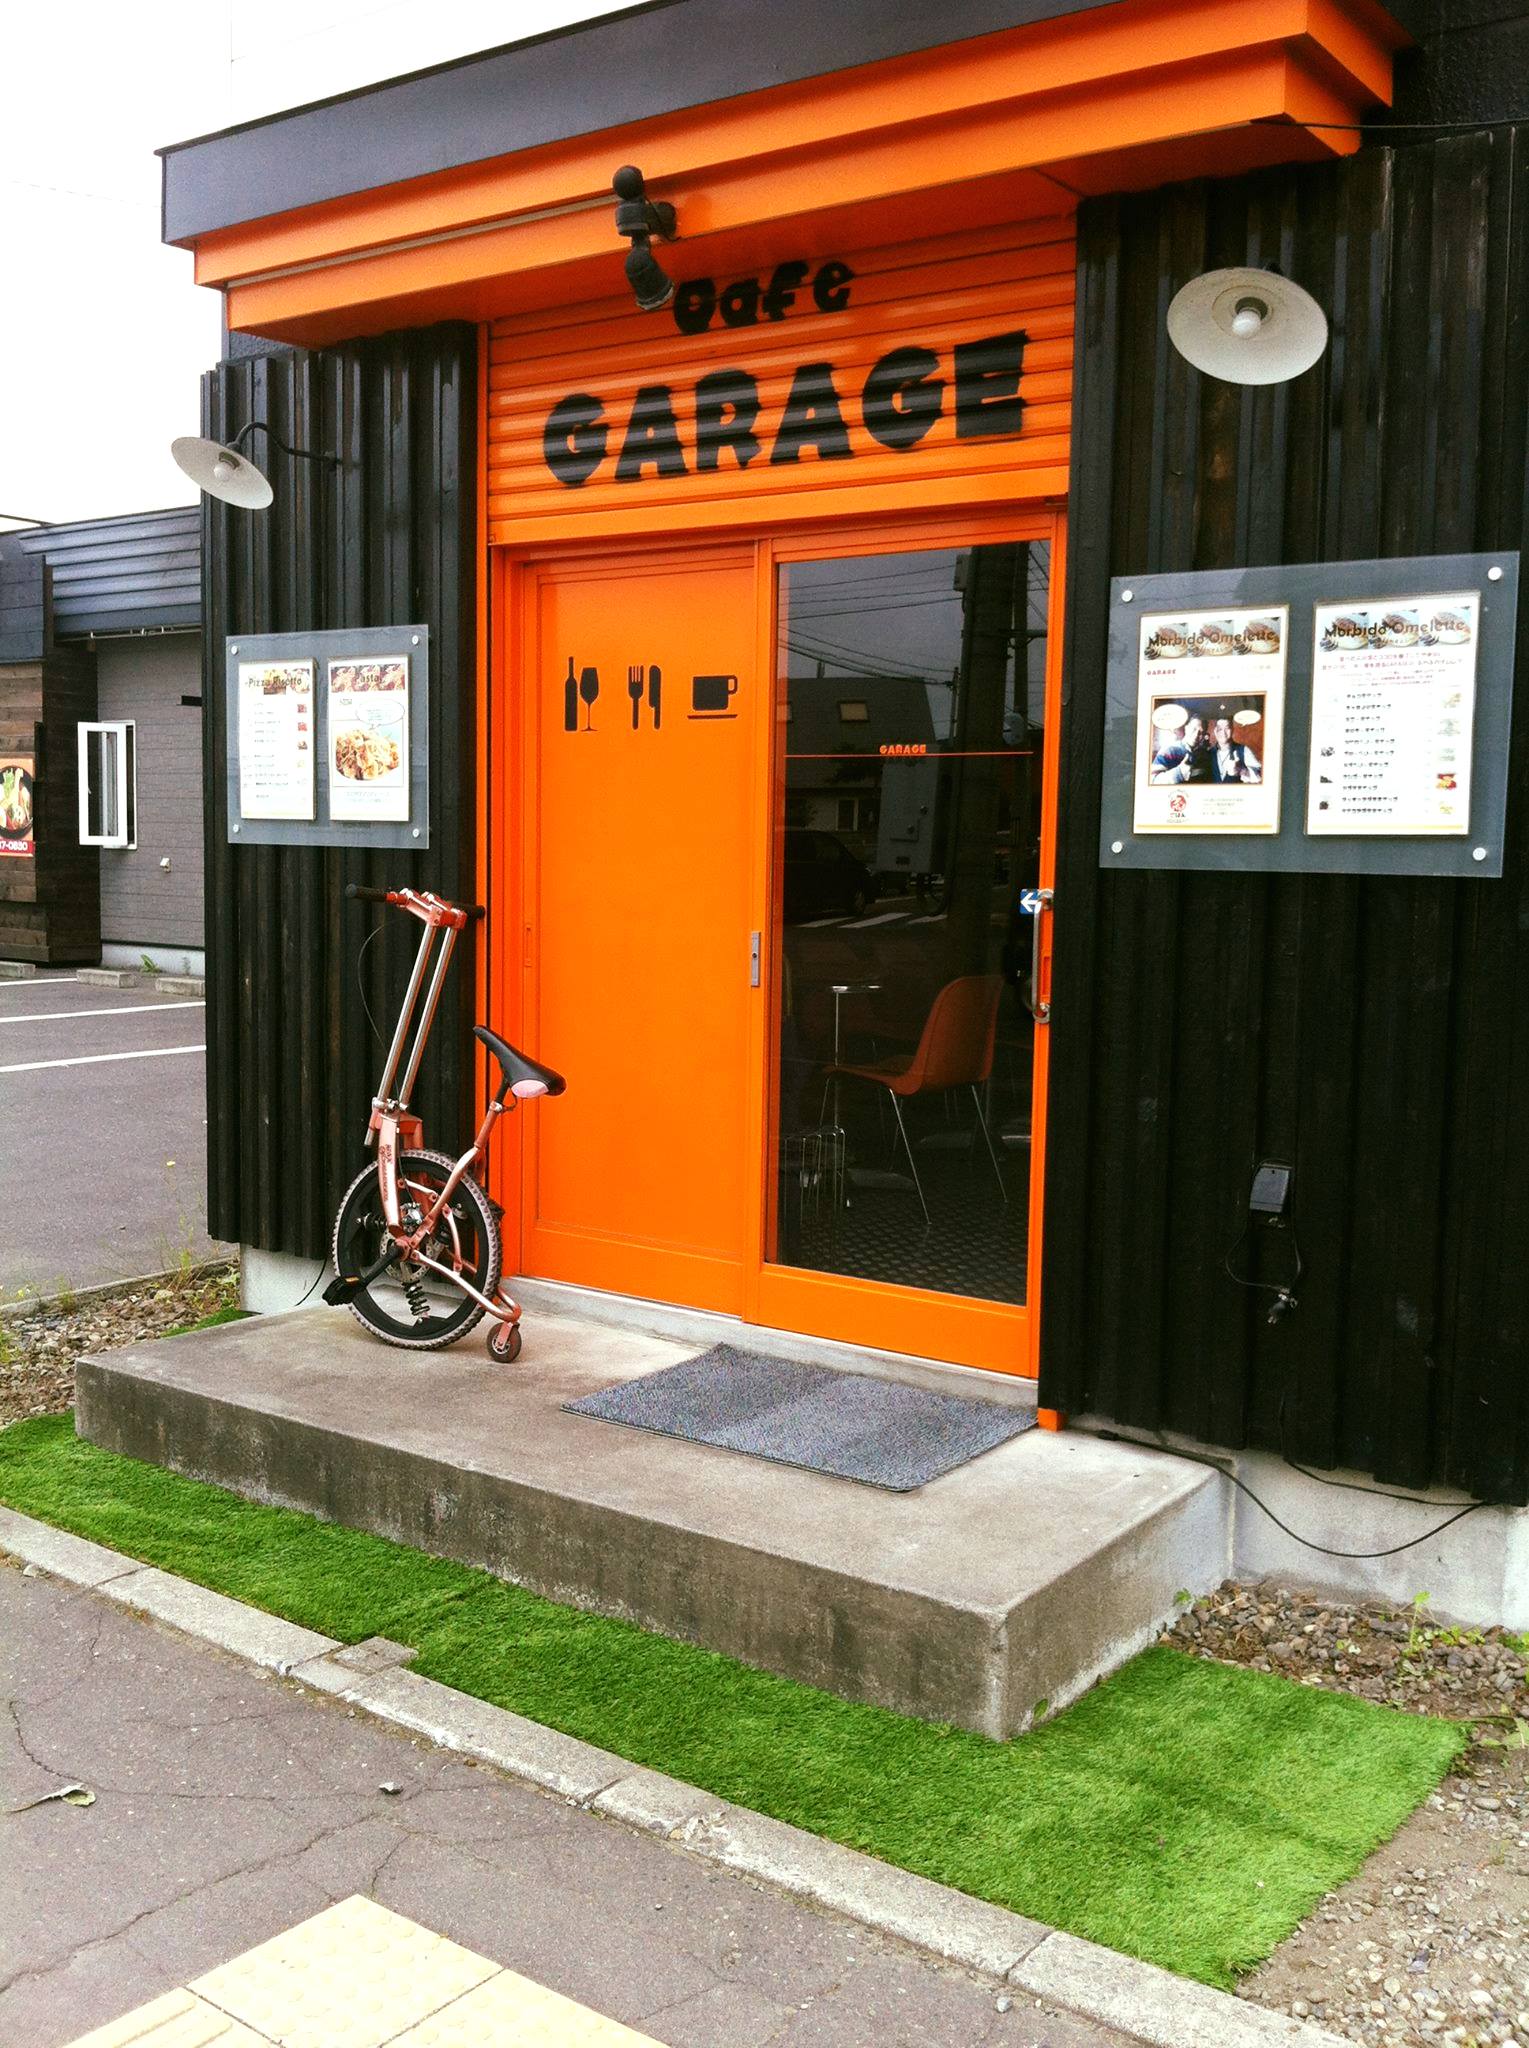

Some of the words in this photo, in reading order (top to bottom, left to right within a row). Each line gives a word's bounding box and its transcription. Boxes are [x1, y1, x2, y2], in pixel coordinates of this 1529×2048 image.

[542, 329, 1029, 488] GARAGE
[1323, 621, 1387, 639] Morbido
[1392, 618, 1465, 635] Omelette
[1148, 631, 1205, 648] Morbido
[879, 743, 927, 755] GARAGE
